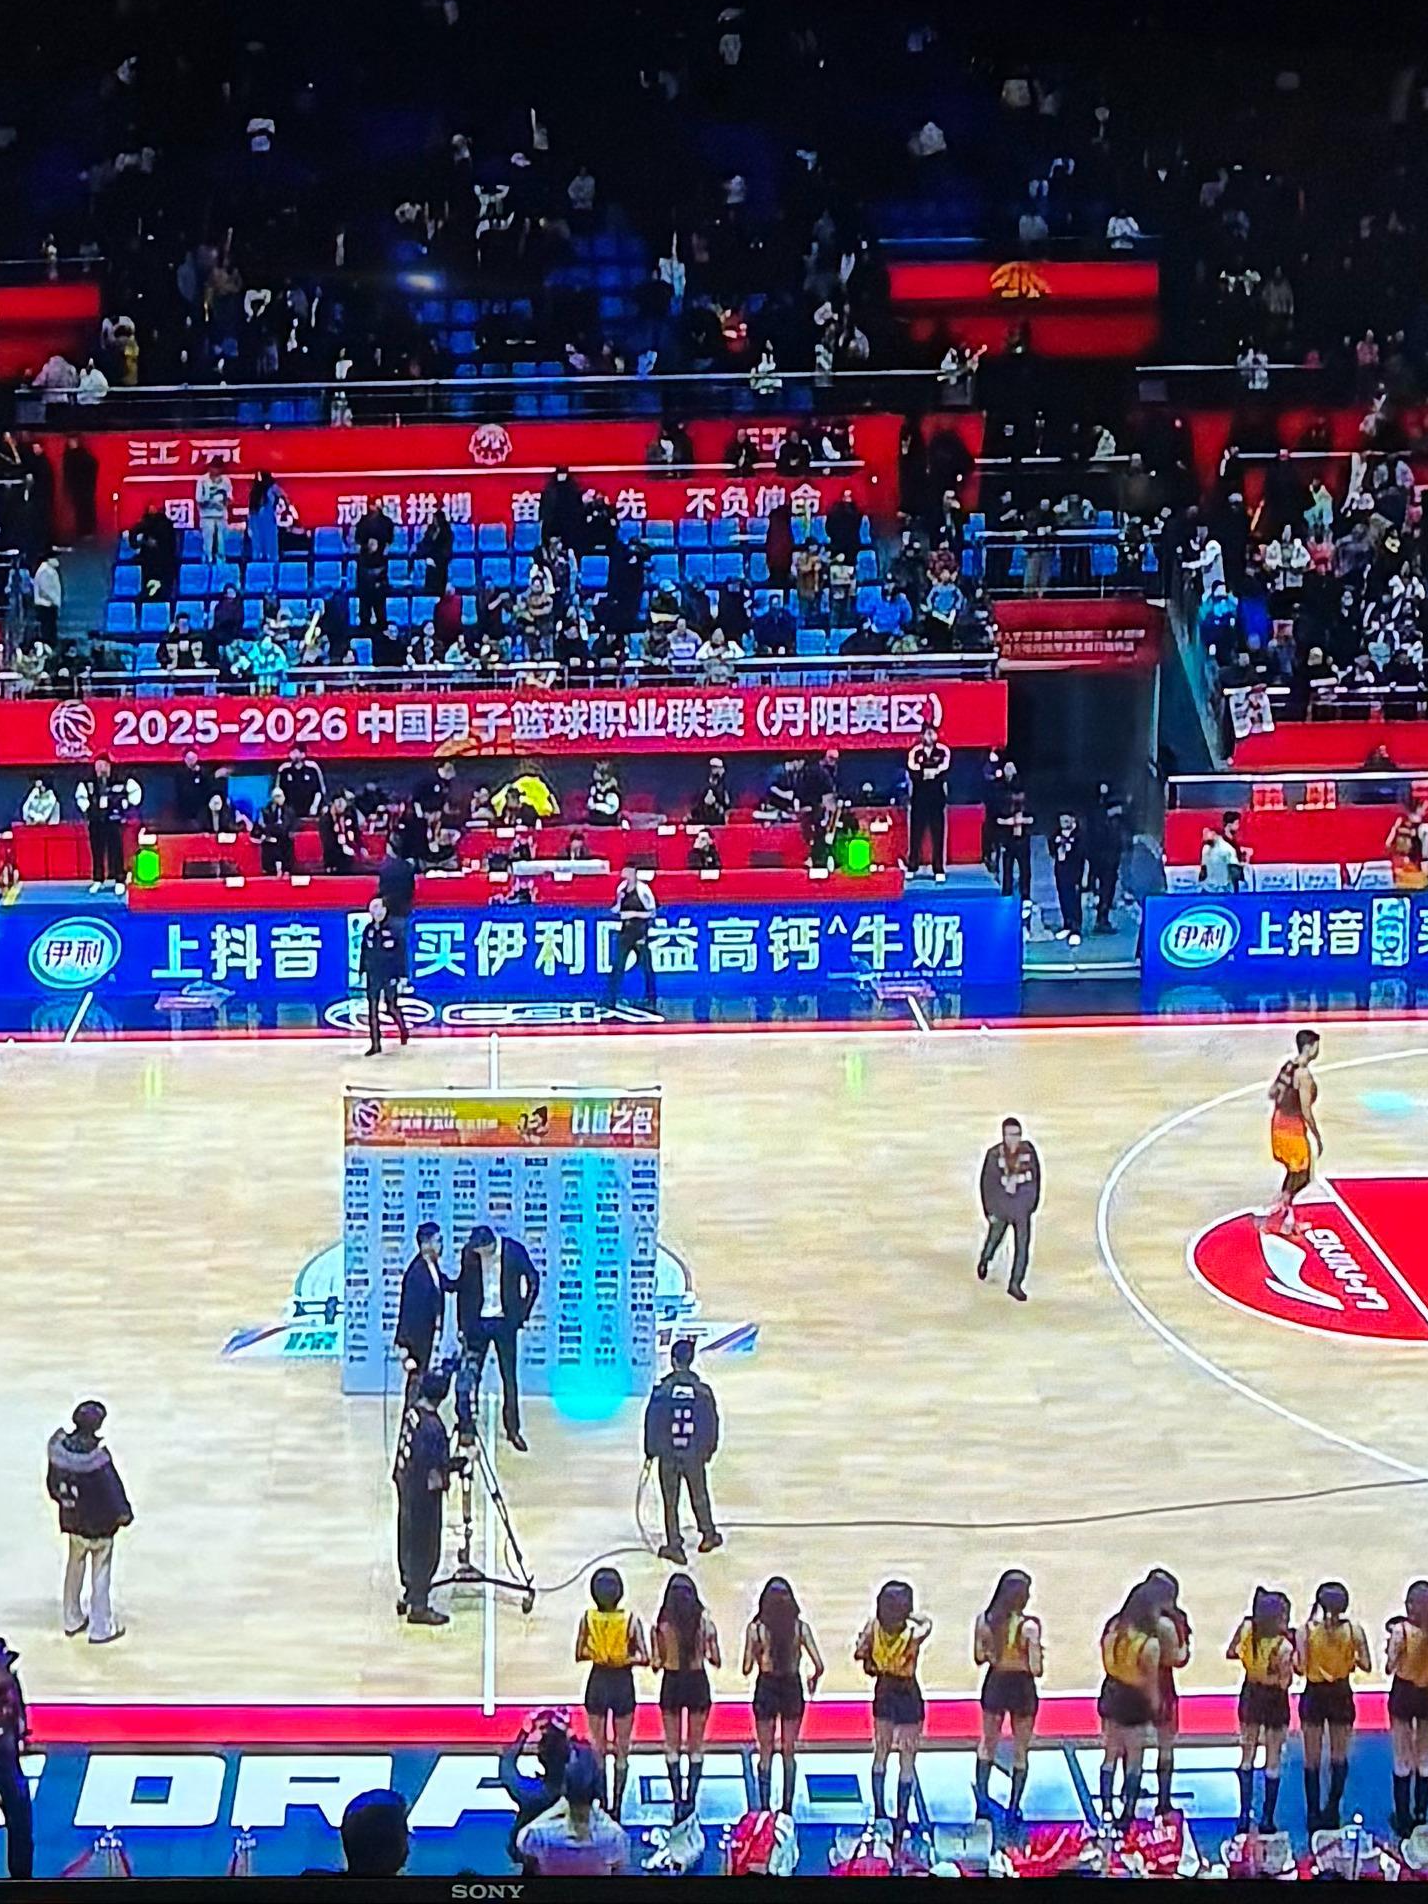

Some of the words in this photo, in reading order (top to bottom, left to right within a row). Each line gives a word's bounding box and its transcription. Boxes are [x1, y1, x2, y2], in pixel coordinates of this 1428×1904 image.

[113, 708, 347, 745] 2025-2026
[1174, 925, 1226, 951] 伊利
[1248, 909, 1364, 957] 上抖音
[42, 939, 104, 967] 伊利
[152, 923, 322, 980] 上抖音
[452, 1884, 525, 1899] SONY
